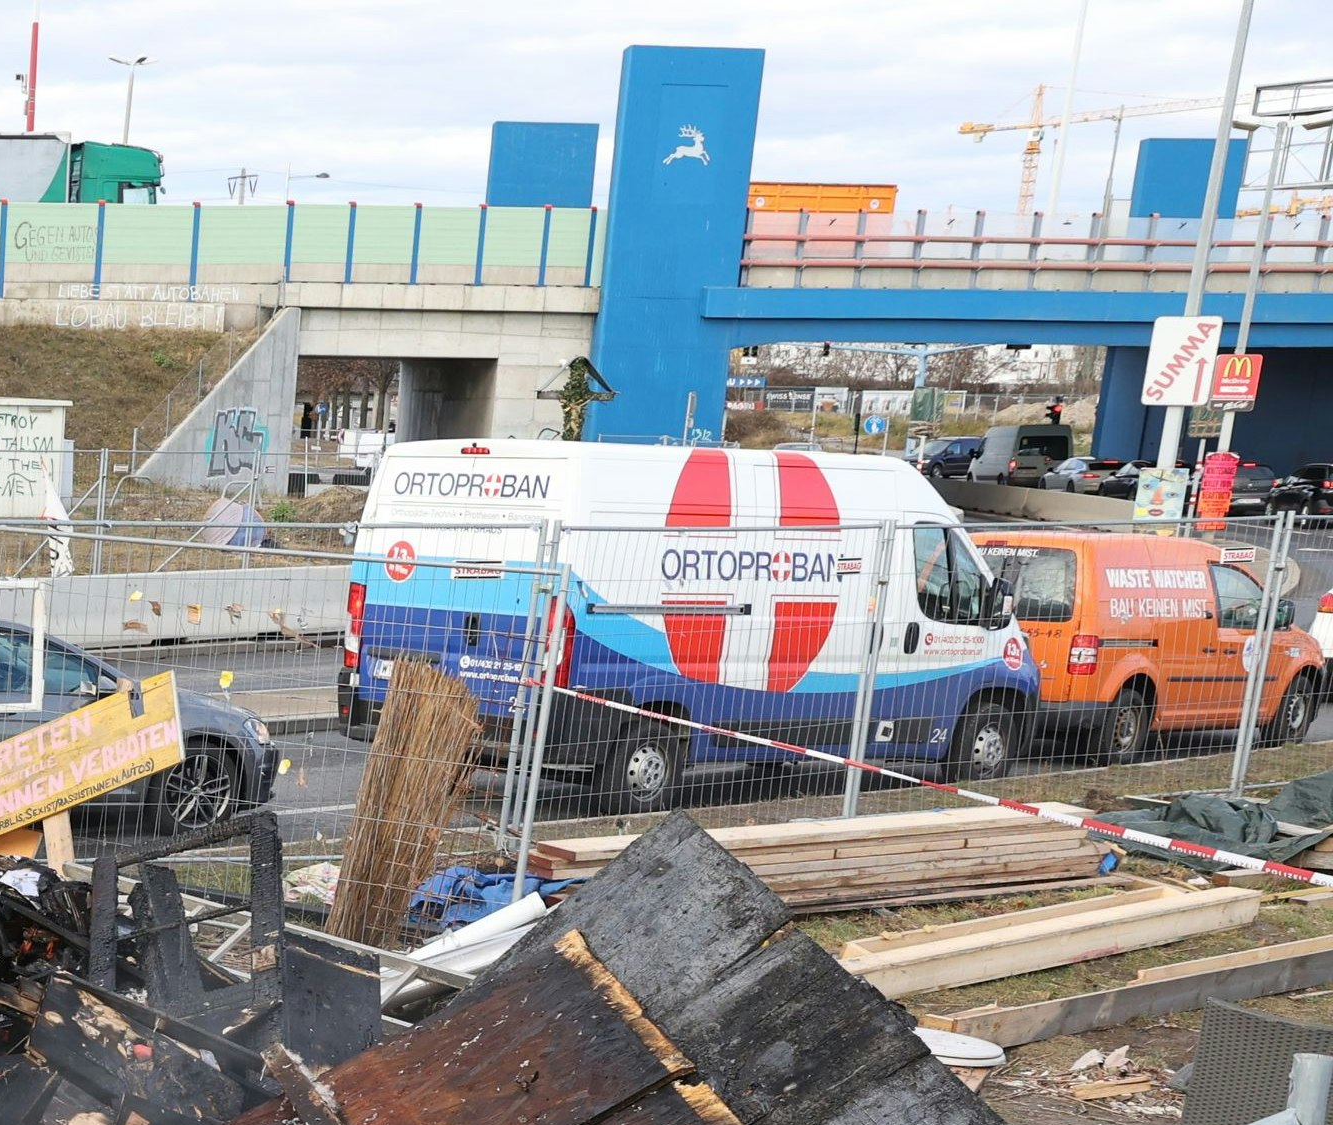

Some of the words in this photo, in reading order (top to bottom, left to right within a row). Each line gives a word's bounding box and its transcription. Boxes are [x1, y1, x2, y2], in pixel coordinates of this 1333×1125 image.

[58, 284, 100, 299] LIEBE
[55, 303, 128, 329] LOBAU
[1146, 321, 1217, 402] SUMMA
[9, 457, 42, 471] THE
[1223, 551, 1254, 562] STRABAG
[837, 559, 862, 572] STRABAG
[1105, 568, 1152, 589] WASTE
[1153, 569, 1207, 590] WATCHER
[1110, 598, 1134, 618] BAU
[1138, 598, 1178, 618] KEINEN
[1182, 599, 1208, 619] MIST
[931, 729, 948, 744] 24
[70, 719, 177, 785] VERBOTEN
[1265, 867, 1302, 881] POLIZEI
